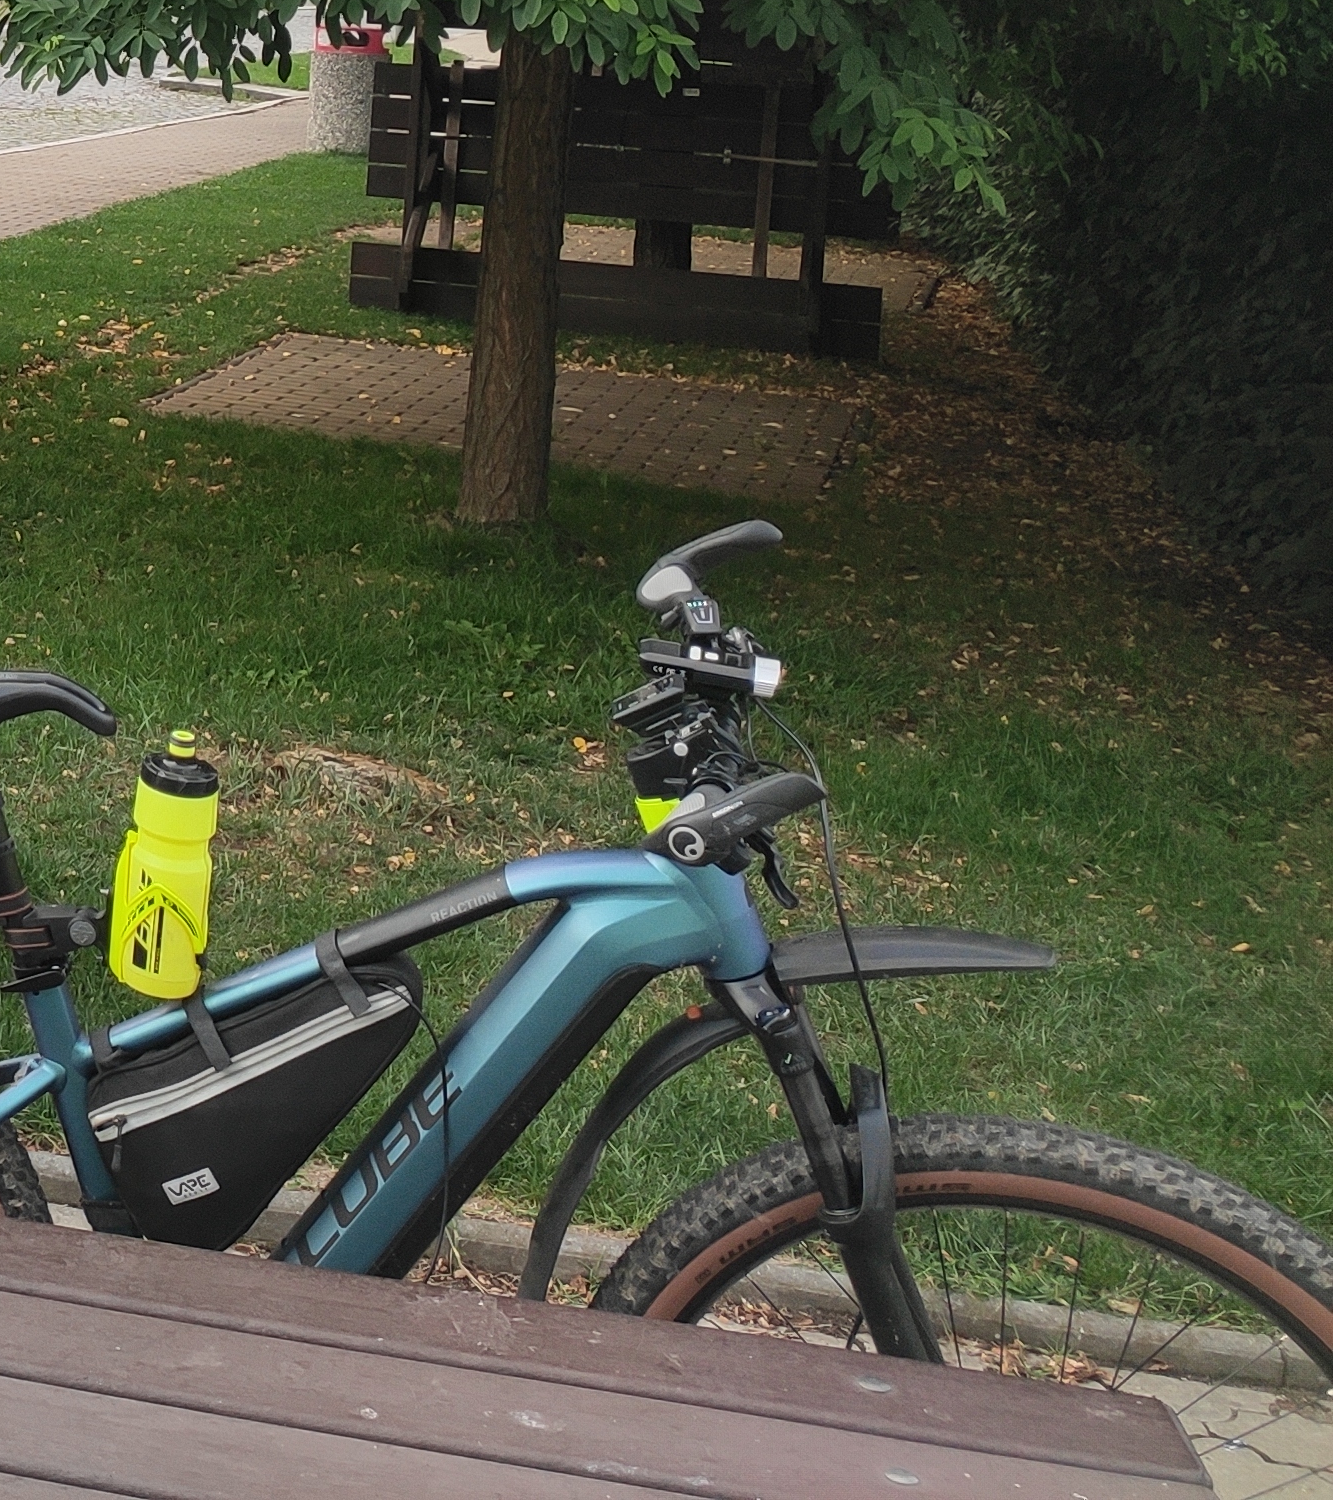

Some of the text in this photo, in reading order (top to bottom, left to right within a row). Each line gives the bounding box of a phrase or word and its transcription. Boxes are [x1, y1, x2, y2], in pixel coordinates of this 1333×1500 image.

[430, 890, 498, 923] REACTION
[294, 1062, 463, 1268] CUBE
[168, 1174, 211, 1197] VAPE
